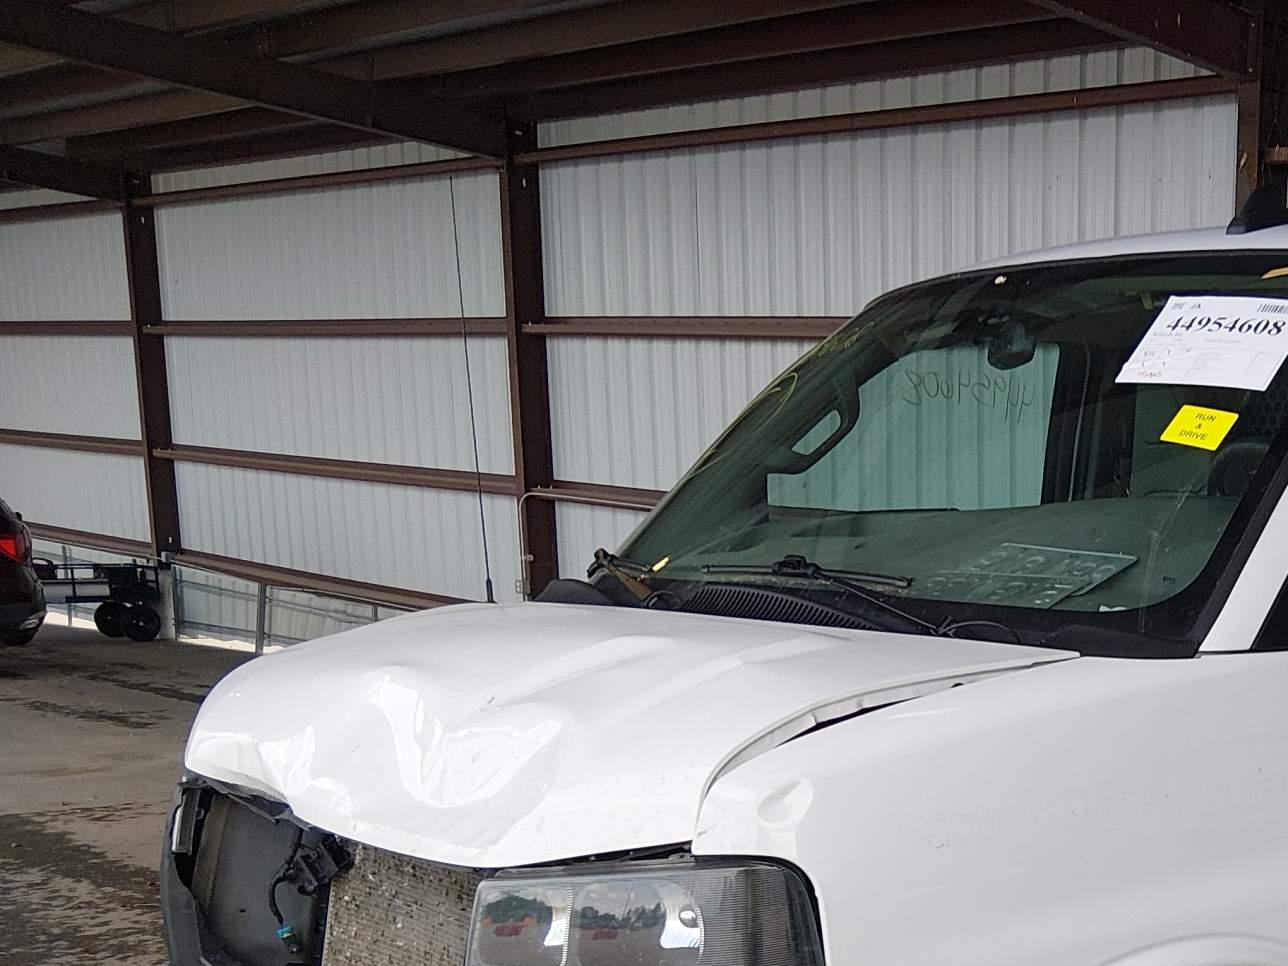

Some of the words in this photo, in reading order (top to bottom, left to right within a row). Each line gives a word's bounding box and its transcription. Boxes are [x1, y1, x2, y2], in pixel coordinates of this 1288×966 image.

[1166, 316, 1286, 336] 44954608
[1195, 412, 1217, 422] RUN
[1179, 429, 1208, 440] DRIVE
